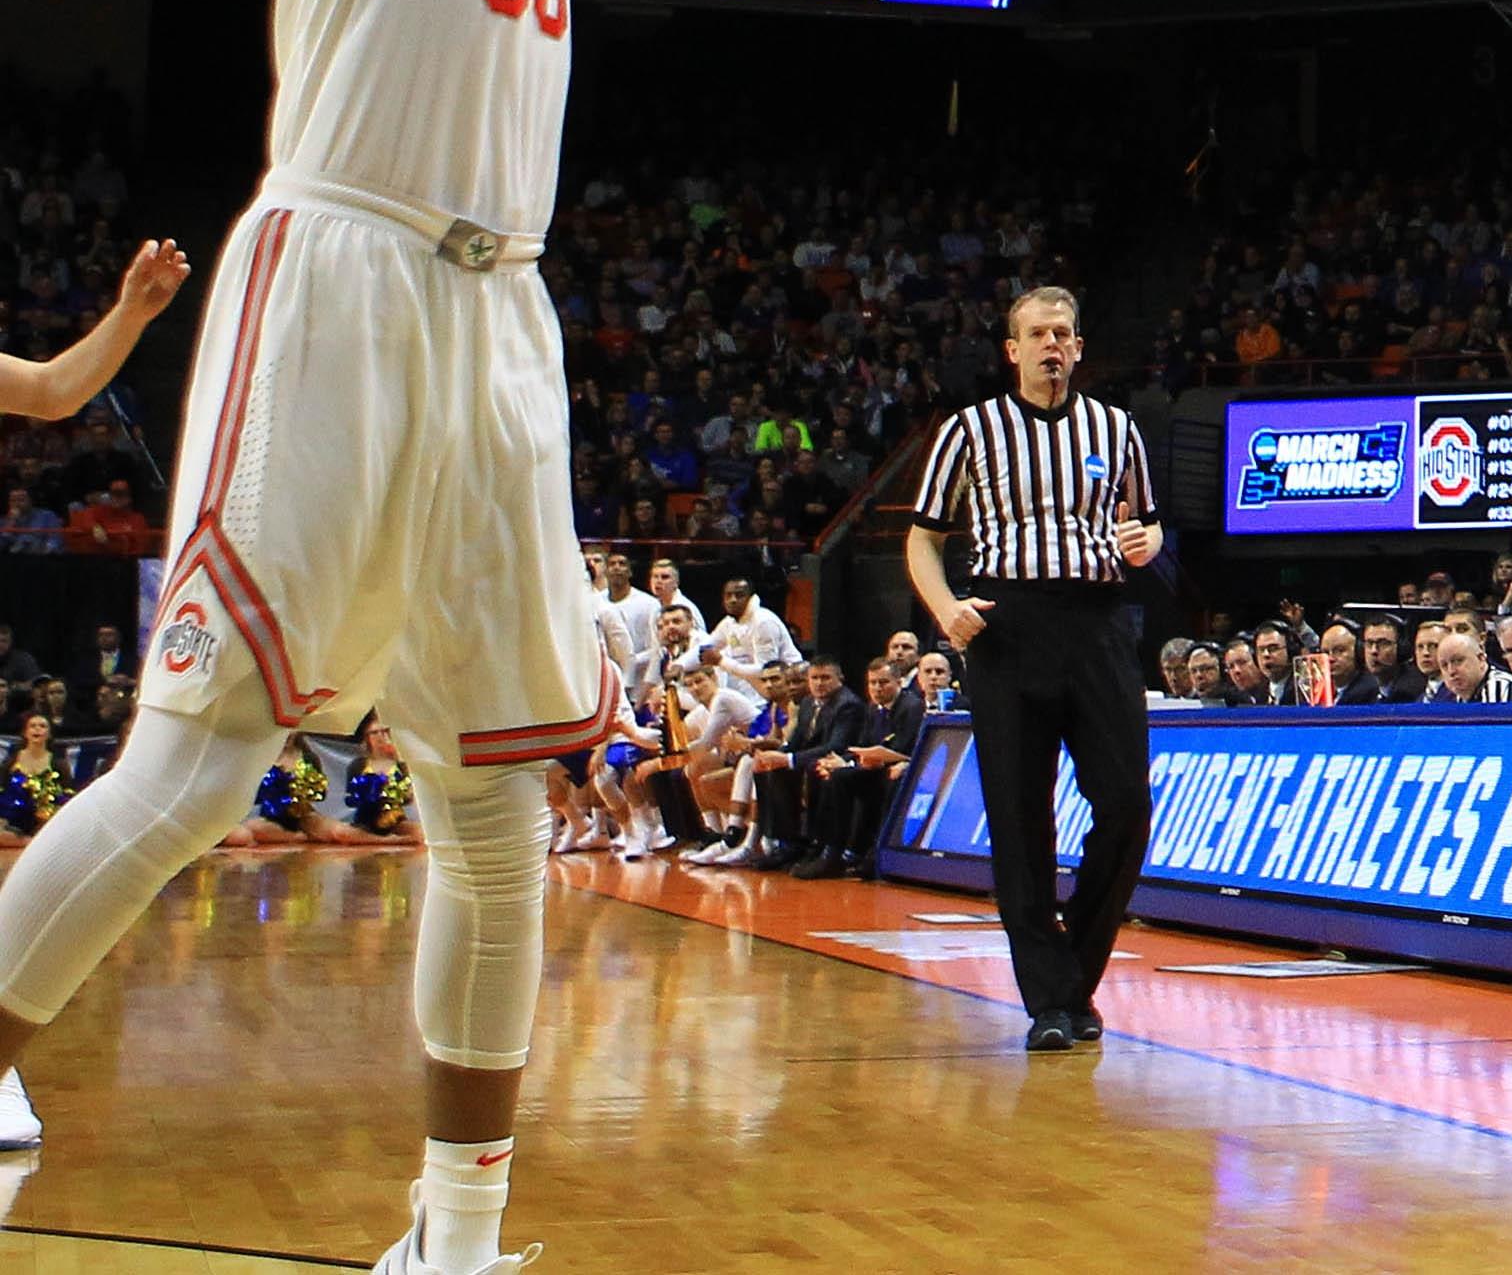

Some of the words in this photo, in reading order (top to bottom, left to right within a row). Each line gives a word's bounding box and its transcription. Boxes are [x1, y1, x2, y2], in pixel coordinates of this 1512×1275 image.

[1276, 432, 1360, 464] MARCH
[1284, 459, 1399, 491] MADNESS
[1149, 751, 1502, 898] STUDENT-ATHLETES
